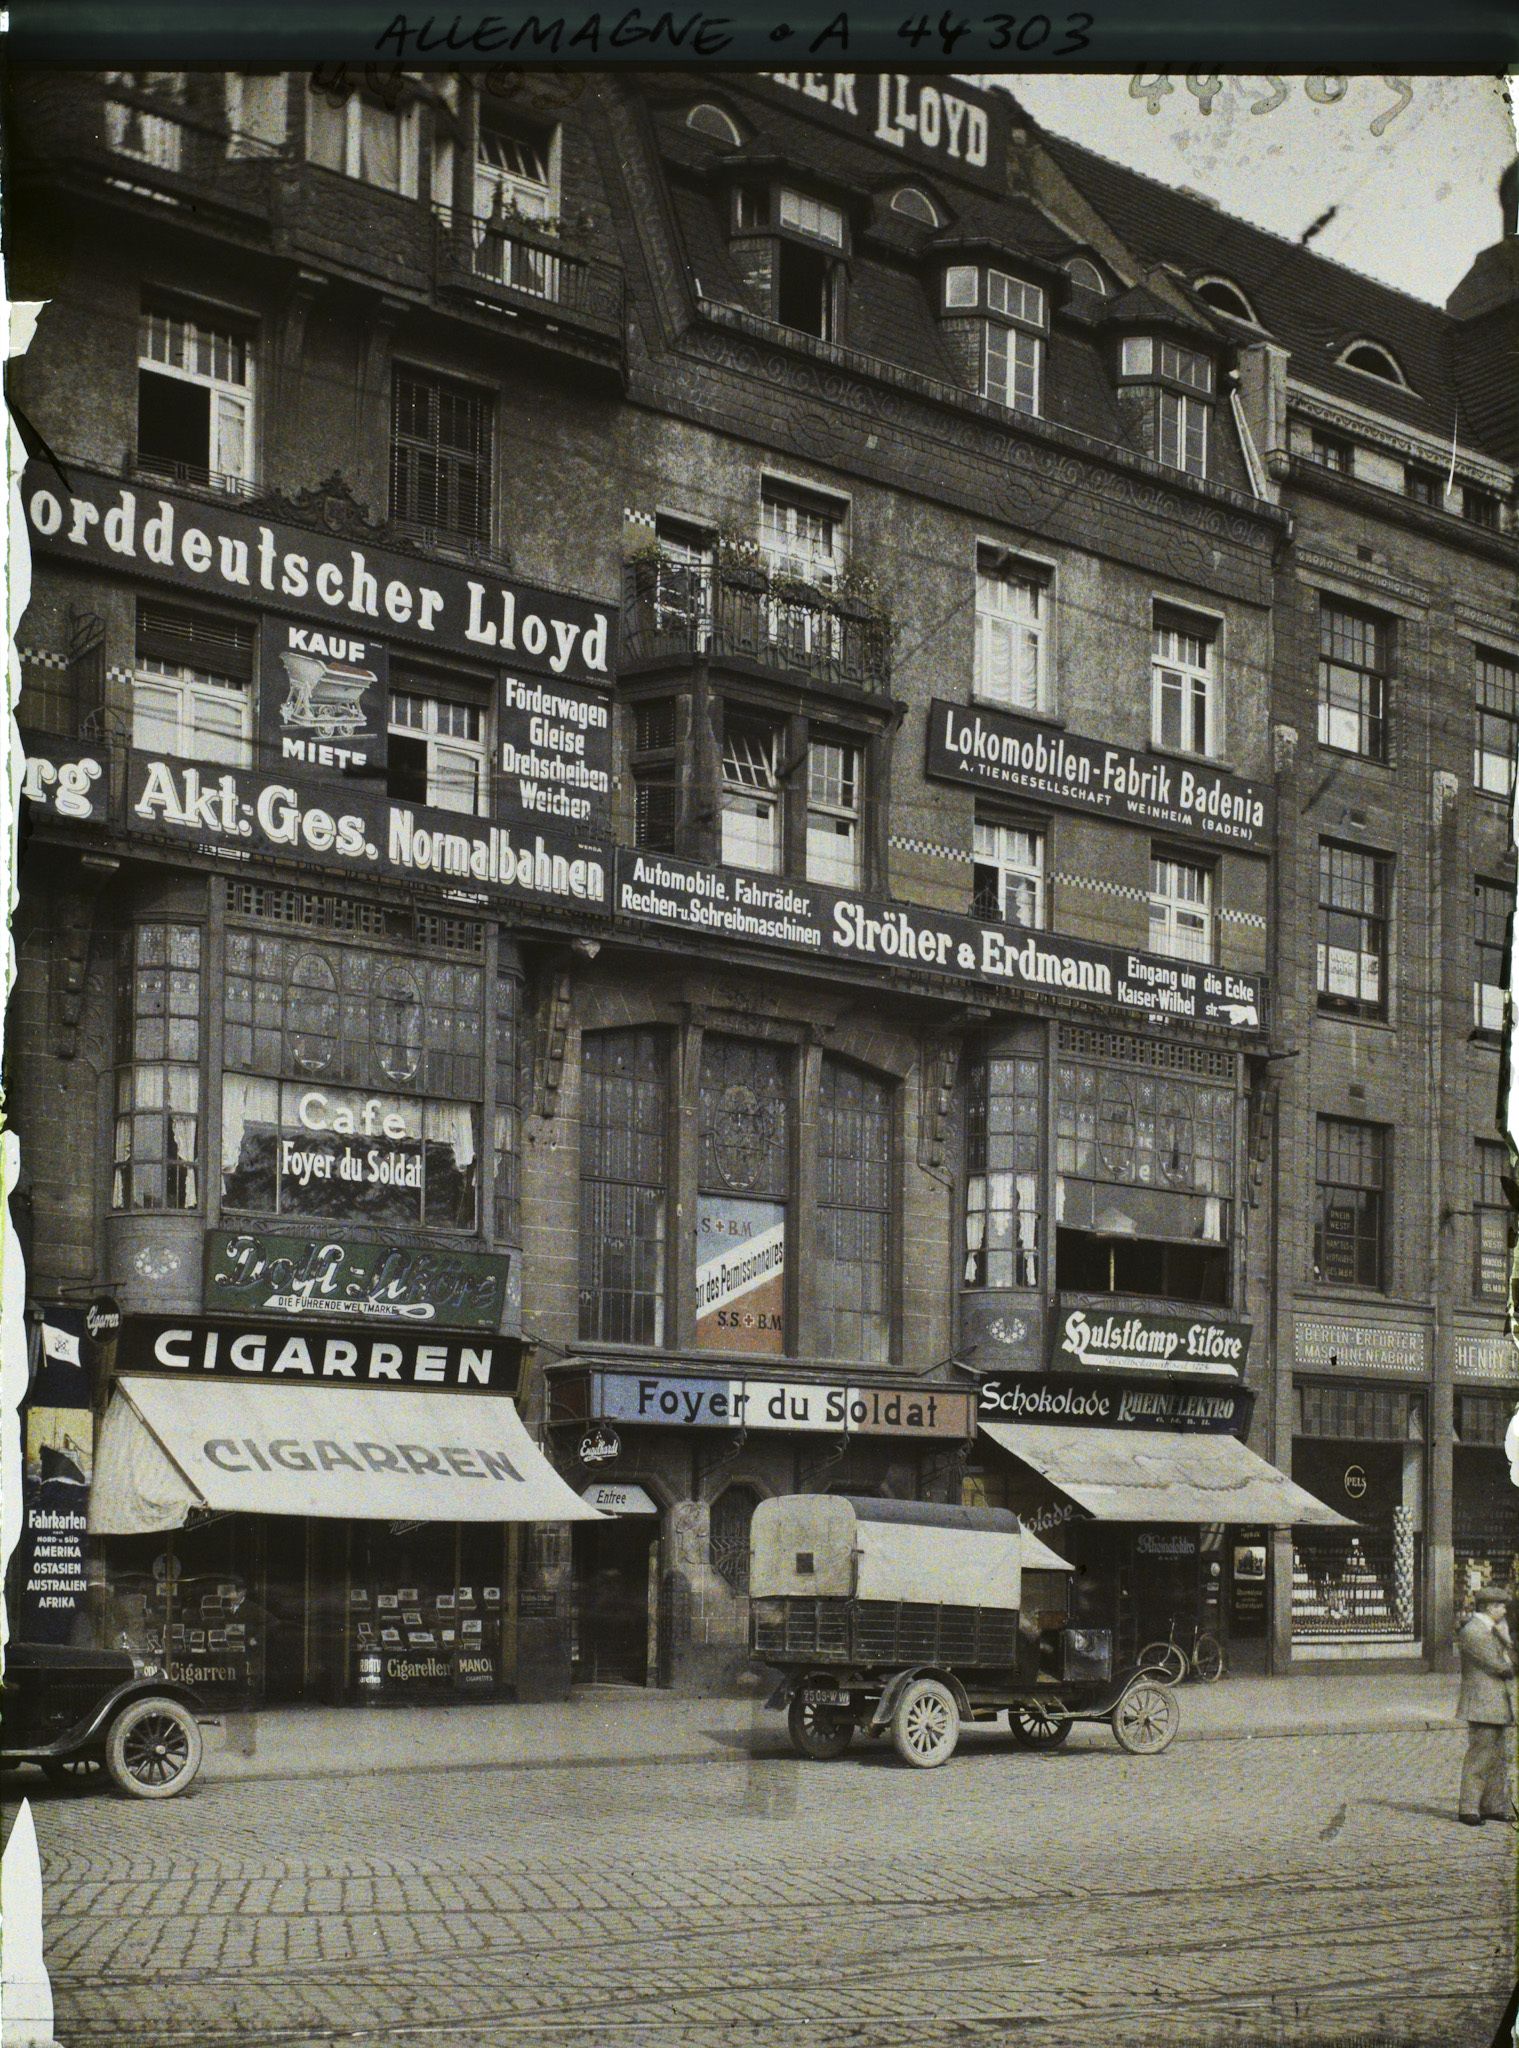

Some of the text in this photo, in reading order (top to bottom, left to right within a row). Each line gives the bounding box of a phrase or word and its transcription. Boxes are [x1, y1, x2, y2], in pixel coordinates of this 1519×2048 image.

[375, 9, 1094, 57] ALLEMAGNE A 44303
[288, 626, 365, 662] KAUF
[465, 581, 608, 673] Lloyd
[506, 677, 607, 729] Förderwagen
[282, 737, 367, 769] MIETE
[530, 717, 585, 755] Gleise
[503, 743, 608, 793] Drehscheiben
[520, 779, 590, 821] Weichen
[1180, 770, 1264, 827] Badenia
[1127, 800, 1193, 826] WEINHEIM
[1202, 817, 1253, 841] (BADEN)
[388, 807, 604, 902] Normalbahnen
[833, 900, 1112, 995] Ströher & Erdmann
[1127, 956, 1177, 991] Eingang
[1203, 972, 1222, 995] die
[1225, 976, 1254, 1002] Ecke
[1205, 1002, 1220, 1017] str.
[282, 1141, 422, 1188] Foyer du Soldat
[706, 1271, 719, 1303] des
[720, 1240, 783, 1297] Permissionnaires
[86, 1304, 119, 1337] Cigarren
[278, 1296, 293, 1307] DIE
[344, 1302, 397, 1314] WELTMARKE
[154, 1329, 493, 1385] CIGARREN
[1305, 1344, 1416, 1366] MASCHINENFABRIK
[1458, 1345, 1505, 1369] HENRY
[638, 1380, 937, 1428] Foyer du Soldat
[979, 1381, 1110, 1421] Schokolade
[203, 1438, 526, 1483] CIGARREN
[596, 1490, 627, 1505] Entree
[1026, 1501, 1073, 1532] olade
[28, 1509, 87, 1530] Fahrkarten
[33, 1545, 82, 1558] AMERIKA
[37, 1536, 57, 1544] NORD
[64, 1535, 79, 1544] SÜD
[27, 1579, 87, 1592] AUSTRALIEN
[33, 1562, 82, 1575] OSTASIEN
[38, 1596, 76, 1609] AFRIKA
[170, 1661, 237, 1685] Cigarren
